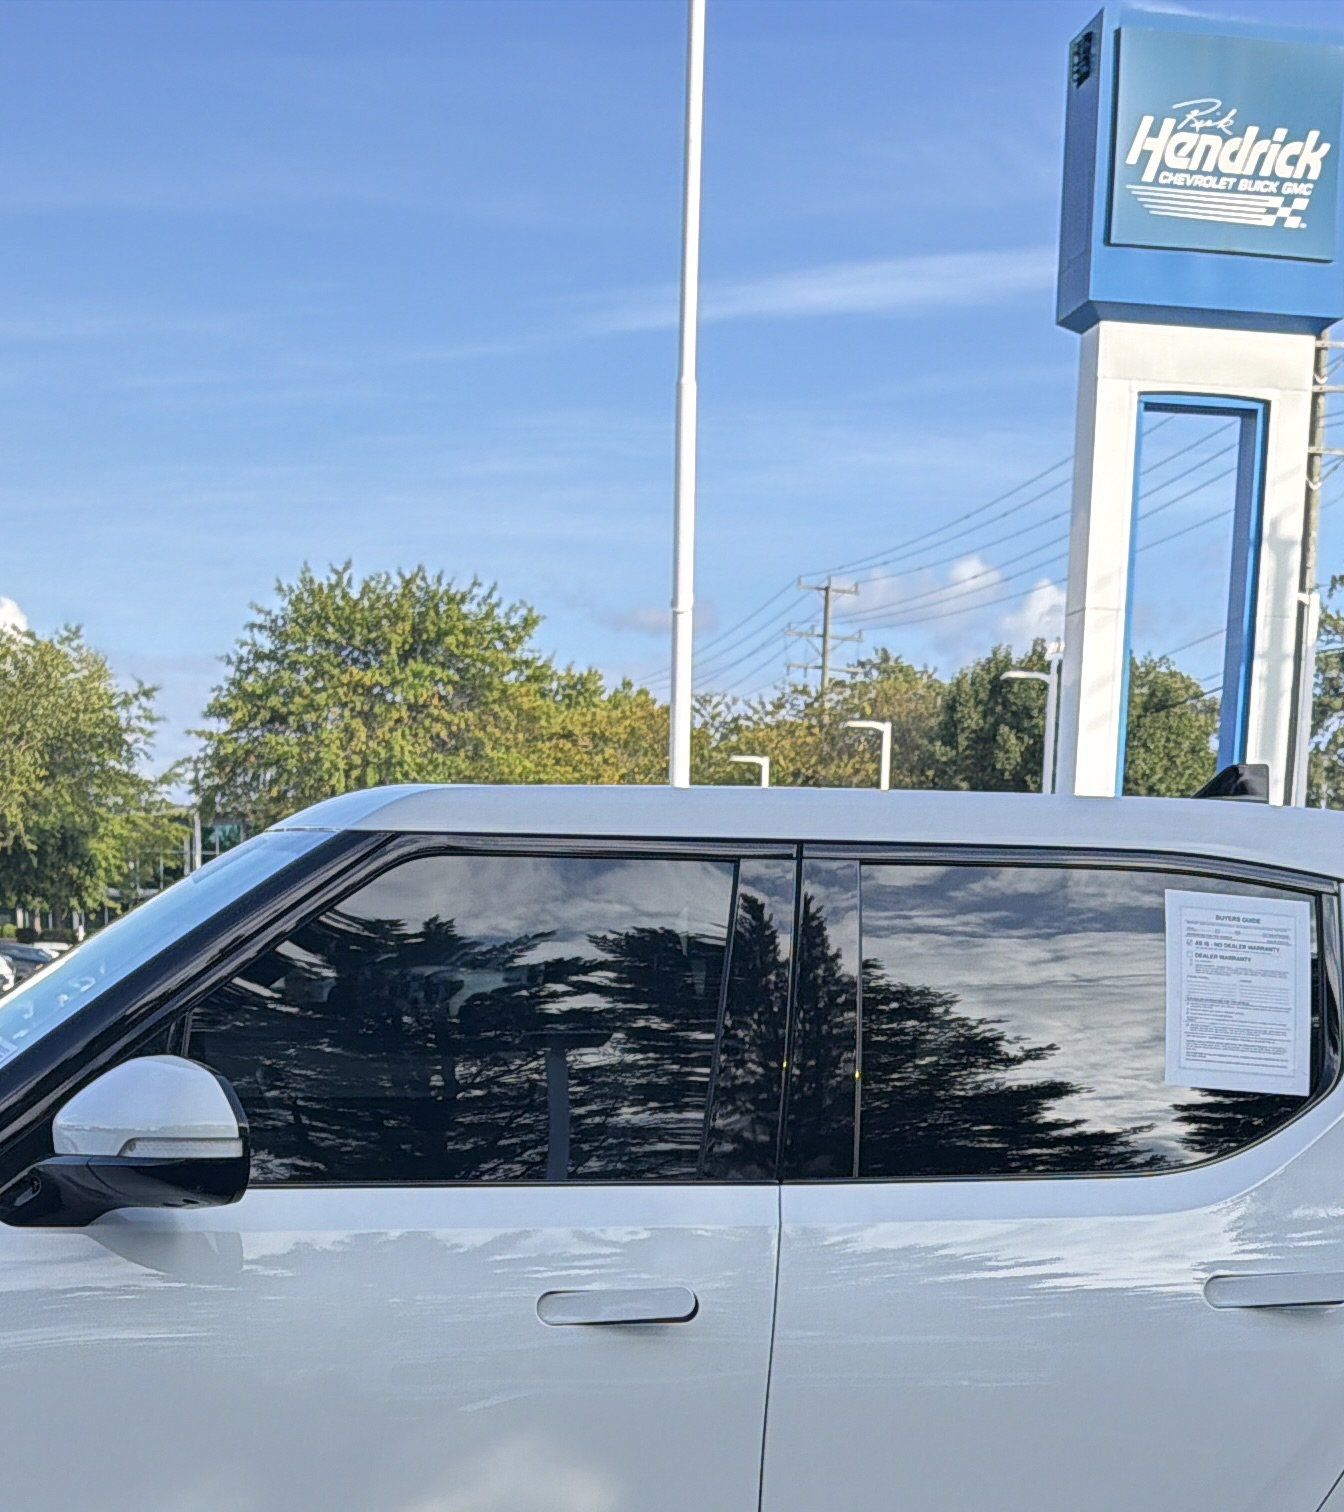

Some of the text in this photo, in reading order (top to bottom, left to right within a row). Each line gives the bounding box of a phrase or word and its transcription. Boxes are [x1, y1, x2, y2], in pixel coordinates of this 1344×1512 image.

[1125, 115, 1331, 182] Hendrick
[1158, 171, 1314, 196] CHEVROLET BUICK GMC
[1215, 914, 1261, 924] BUYERS GUIDE
